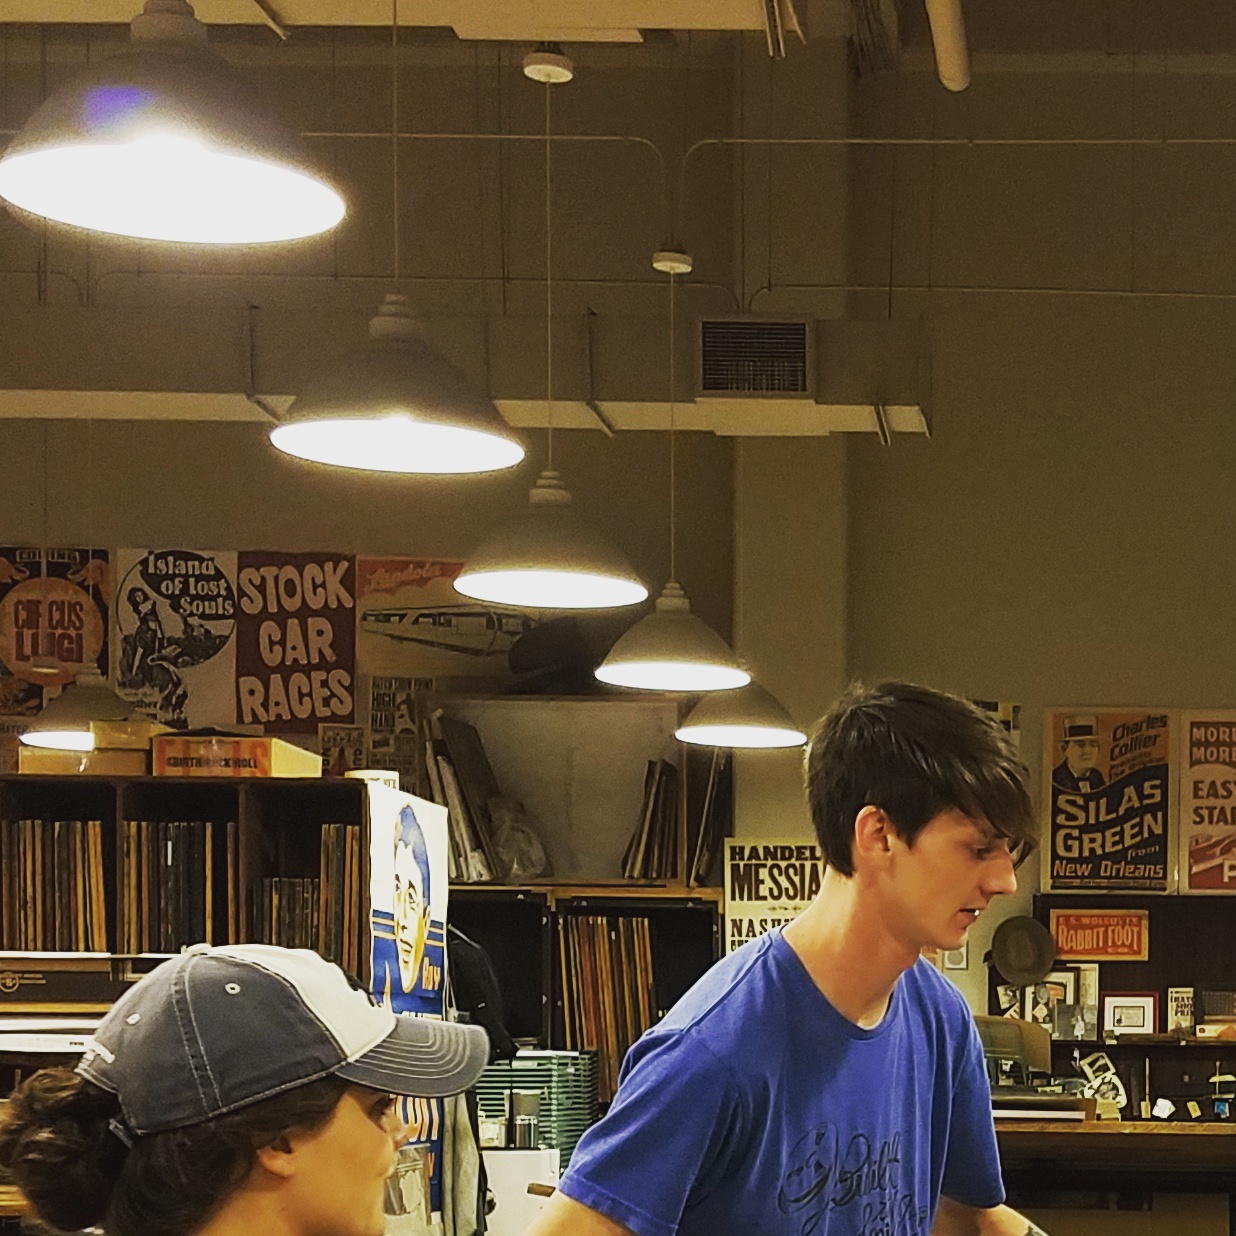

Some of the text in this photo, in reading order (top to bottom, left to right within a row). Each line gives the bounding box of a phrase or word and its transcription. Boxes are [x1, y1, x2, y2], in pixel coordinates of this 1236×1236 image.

[147, 552, 215, 575] Island
[160, 578, 183, 595] of
[238, 560, 354, 615] STOCK
[180, 596, 234, 616] Souls
[259, 617, 337, 667] CAR
[238, 669, 353, 723] RACES
[1056, 781, 1162, 826] SILAS
[1056, 811, 1163, 858] GREEN
[729, 845, 821, 861] HANDEL
[1128, 845, 1159, 861] from
[730, 863, 823, 901] MESSIA
[1053, 860, 1164, 877] New Orleans
[1058, 924, 1140, 951] RABBIT FOOT
